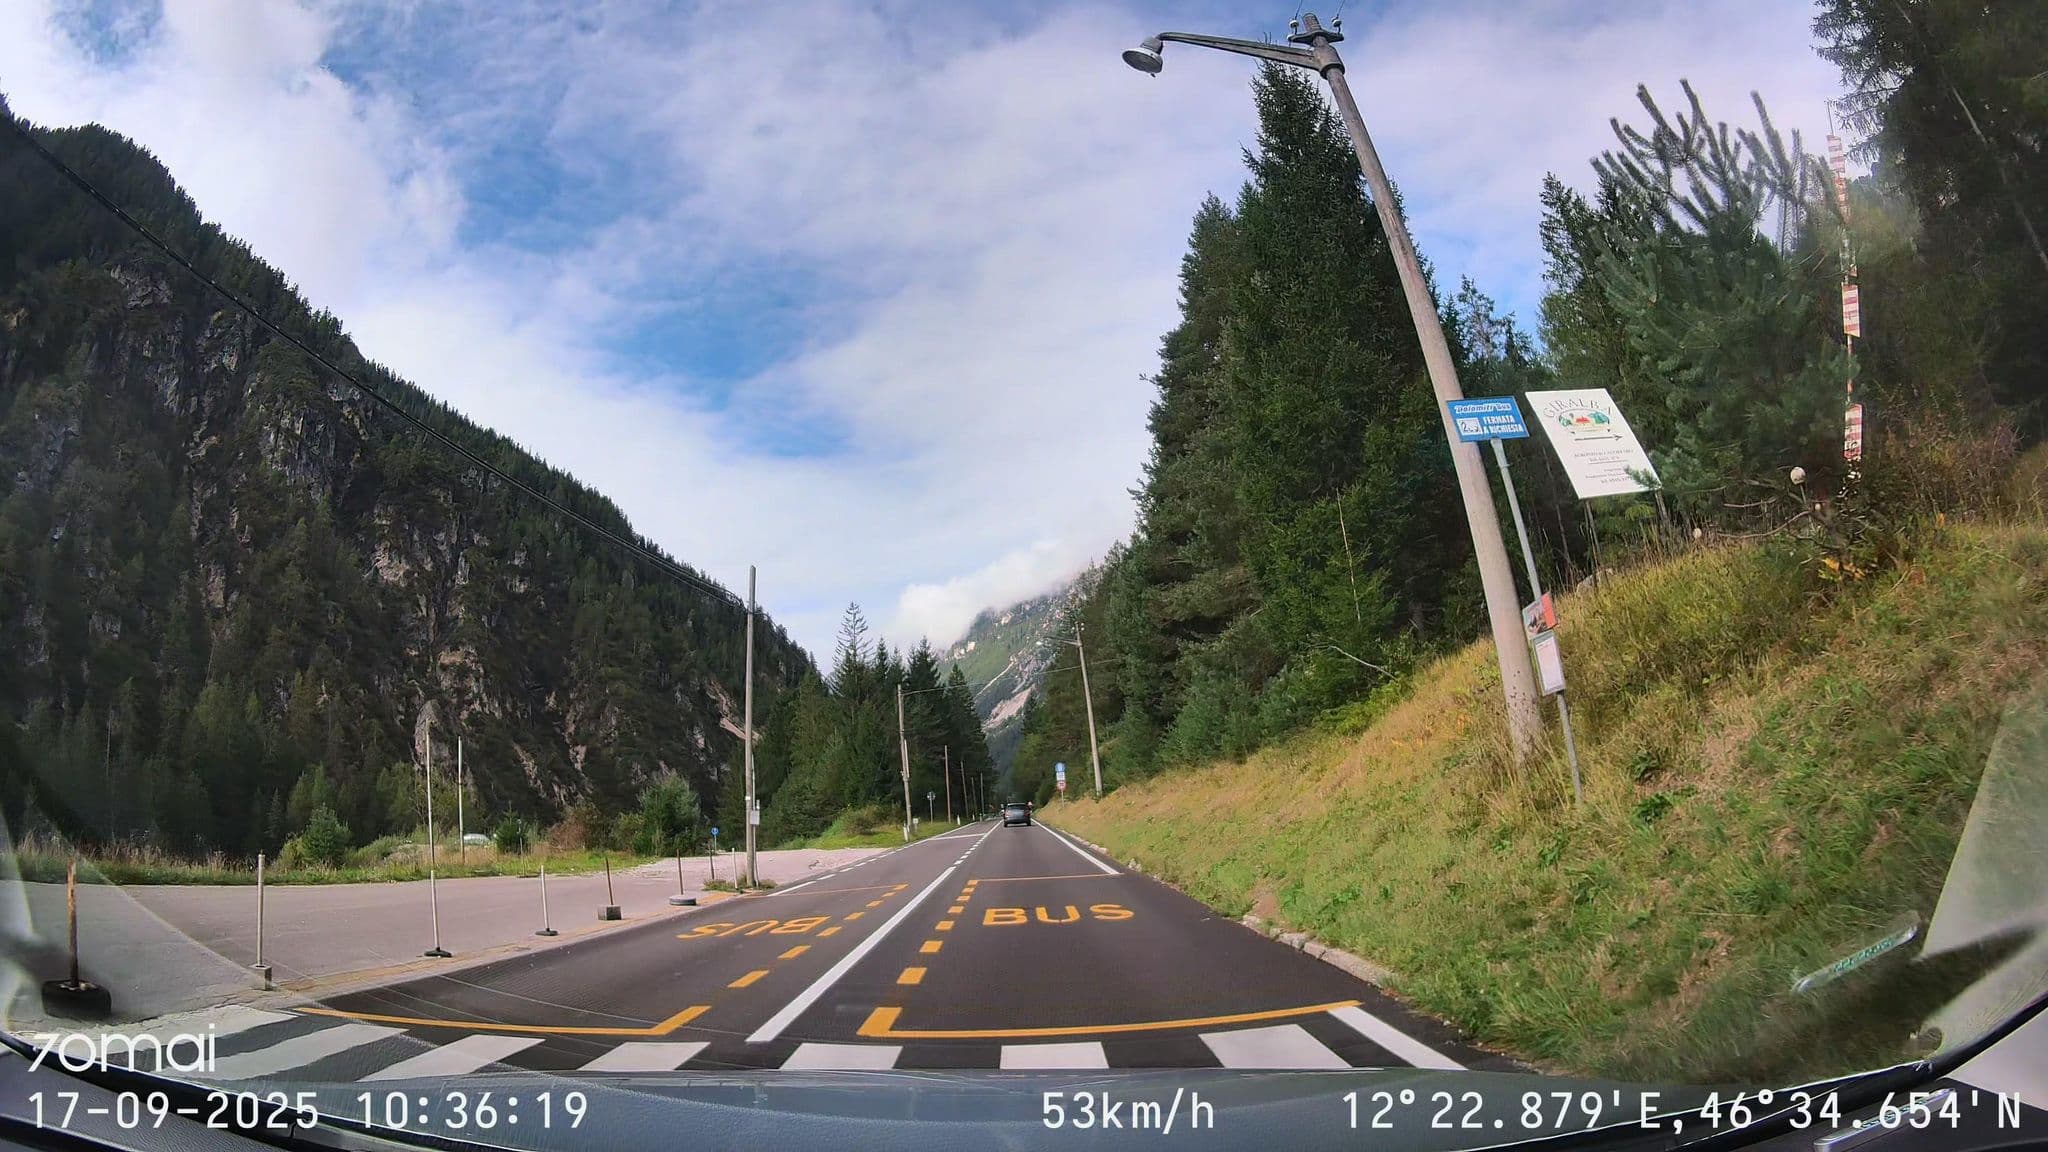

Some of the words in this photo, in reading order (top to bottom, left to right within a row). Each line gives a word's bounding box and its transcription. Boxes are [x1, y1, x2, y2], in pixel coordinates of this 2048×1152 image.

[1483, 415, 1516, 425] FERMATA
[982, 904, 1135, 926] BUS
[676, 915, 832, 939] BUS
